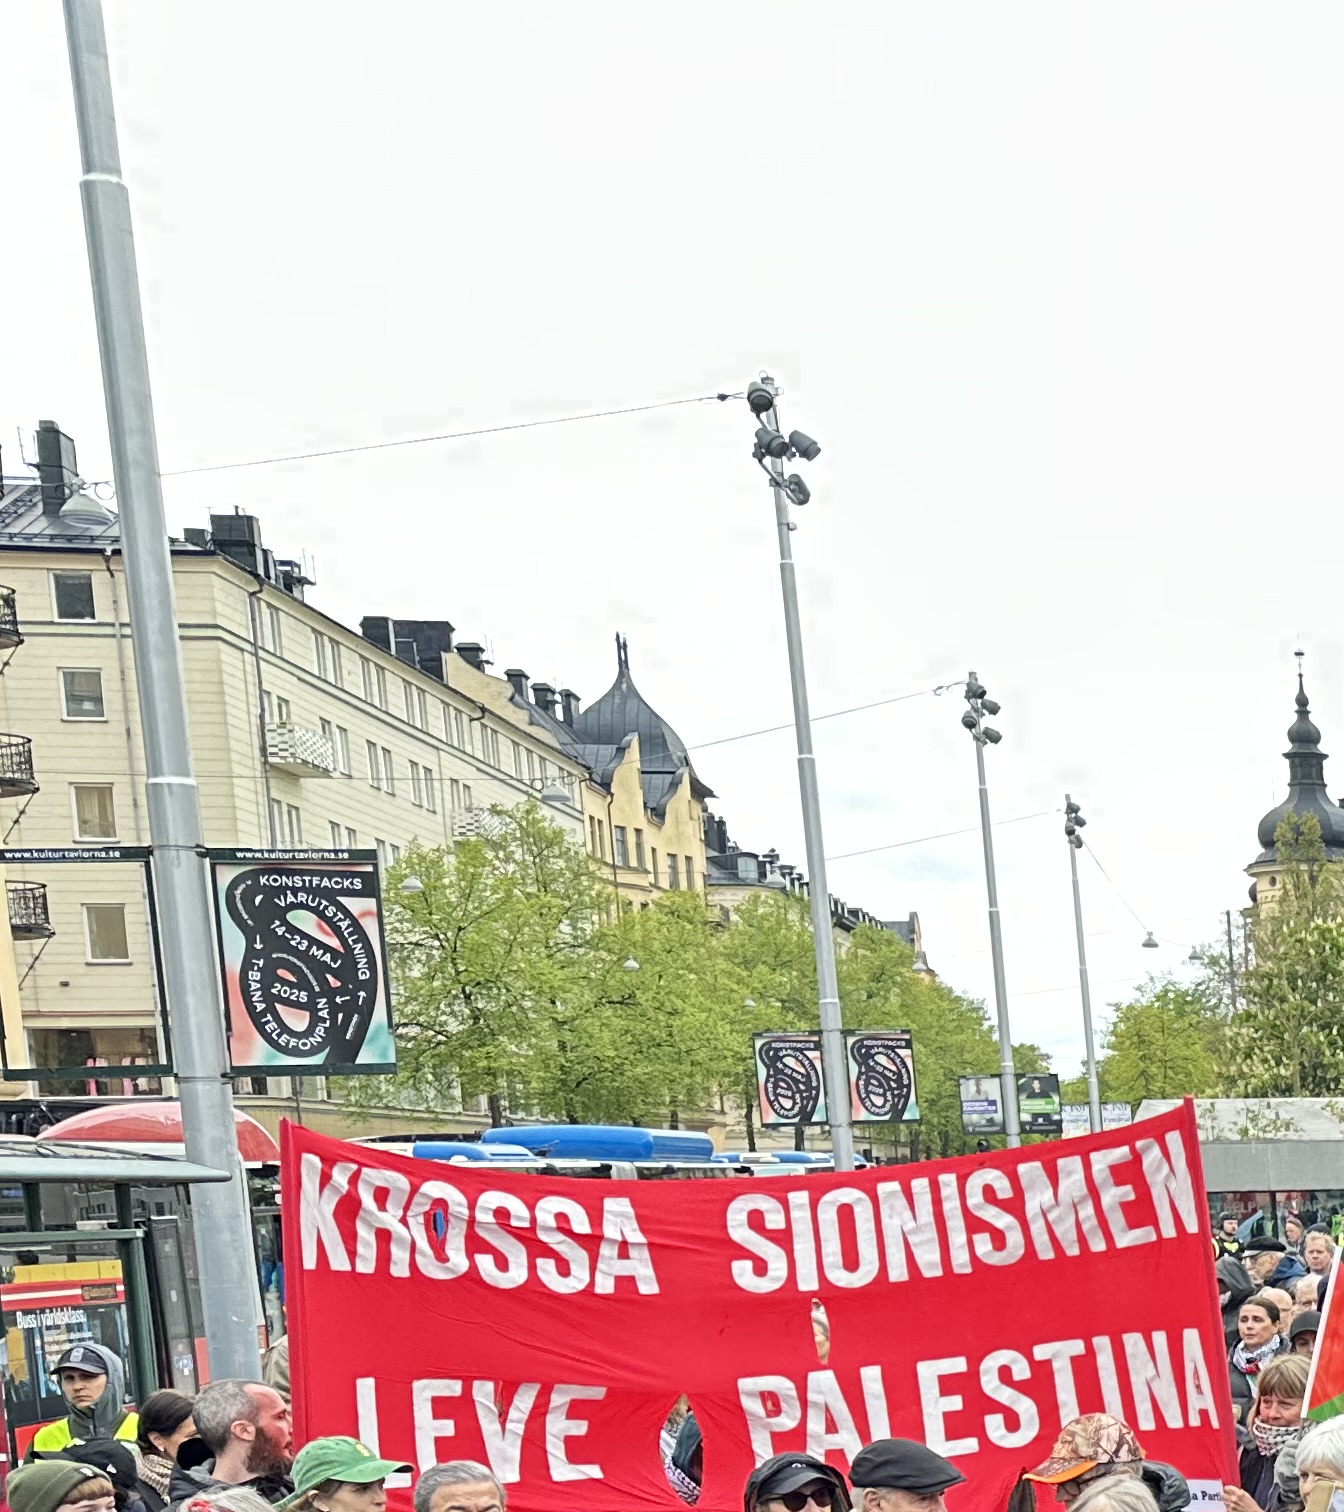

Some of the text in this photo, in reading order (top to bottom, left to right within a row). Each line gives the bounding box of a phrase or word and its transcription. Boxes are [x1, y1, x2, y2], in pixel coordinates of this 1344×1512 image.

[259, 875, 362, 890] KONSTFACKS
[274, 890, 370, 980] VÅRUTSTÄLLNING
[308, 945, 341, 968] MAJ
[247, 958, 266, 1013] T-BANA
[261, 997, 330, 1050] TELEFONPLAN
[271, 983, 308, 1003] 2025
[301, 1130, 1198, 1295] KROSSA SIONISMEN
[16, 1311, 36, 1329] Buss
[356, 1328, 1219, 1489] LEVE PALESTINA
